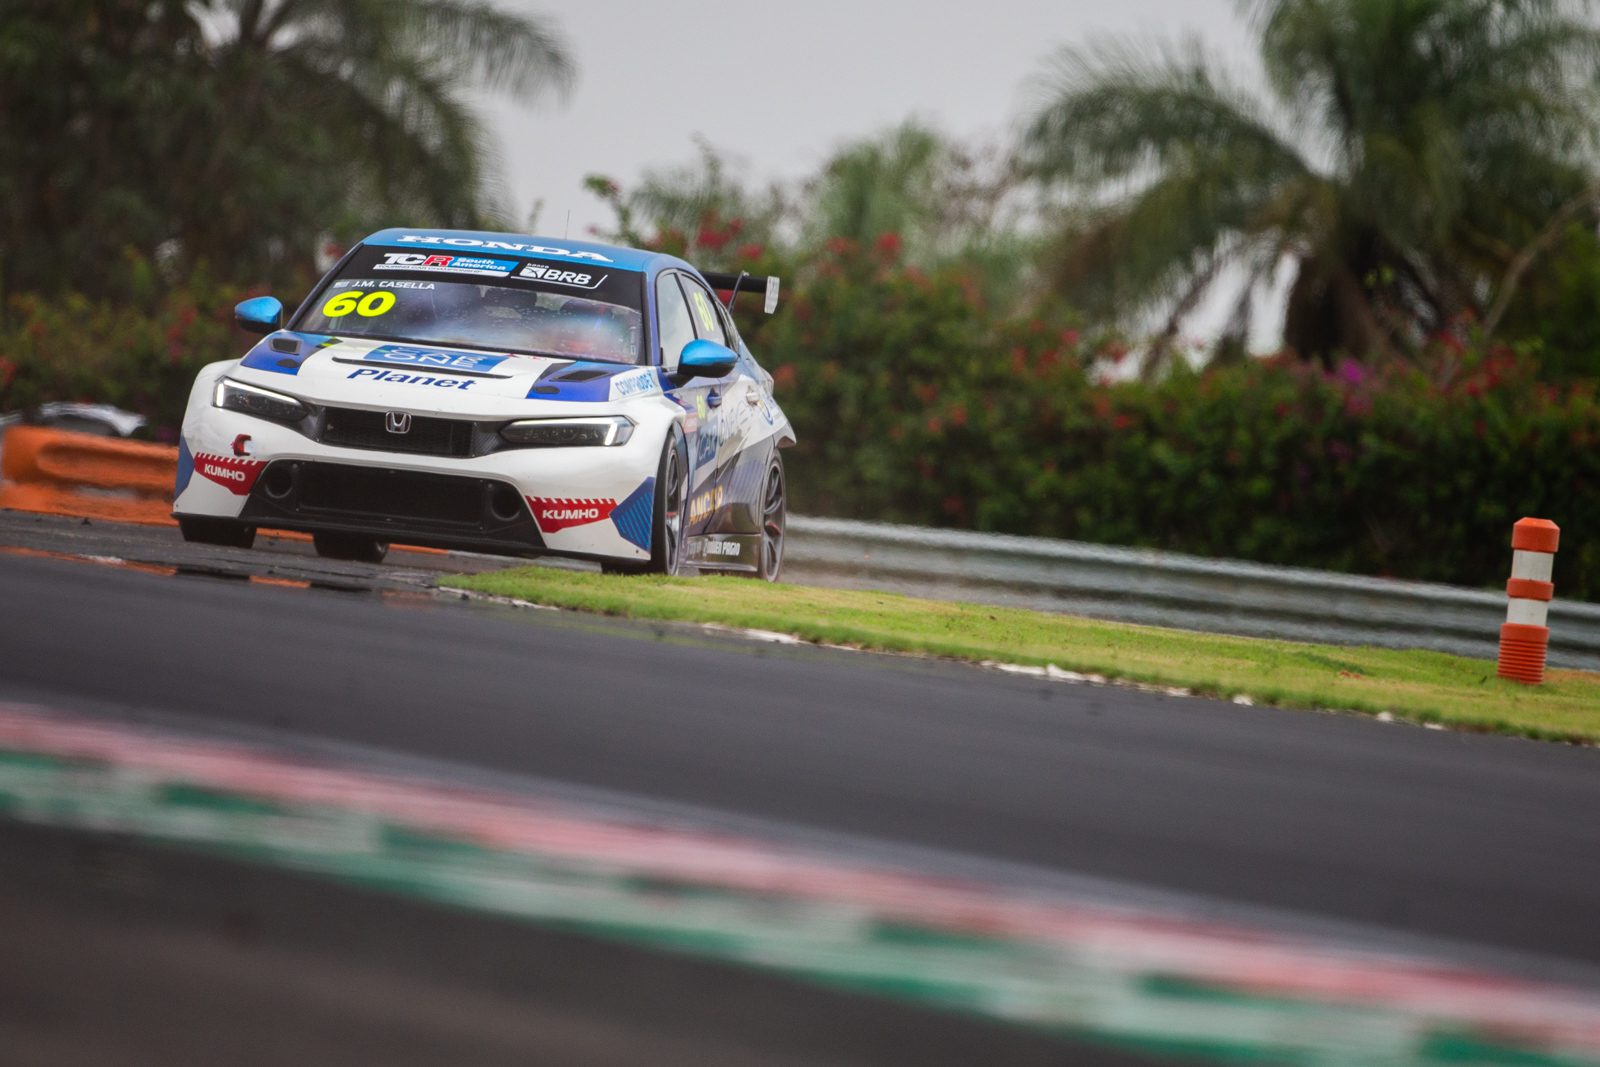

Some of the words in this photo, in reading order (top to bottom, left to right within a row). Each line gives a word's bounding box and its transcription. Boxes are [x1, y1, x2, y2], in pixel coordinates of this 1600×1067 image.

[397, 235, 614, 262] HONDA
[384, 253, 454, 267] TCR
[455, 257, 495, 265] South
[452, 262, 506, 271] America
[543, 269, 592, 285] BRB
[378, 281, 436, 290] CASELLA
[322, 290, 396, 318] 60
[347, 368, 478, 390] Planet
[204, 463, 246, 482] KUMHO
[542, 508, 600, 520] KUMHO
